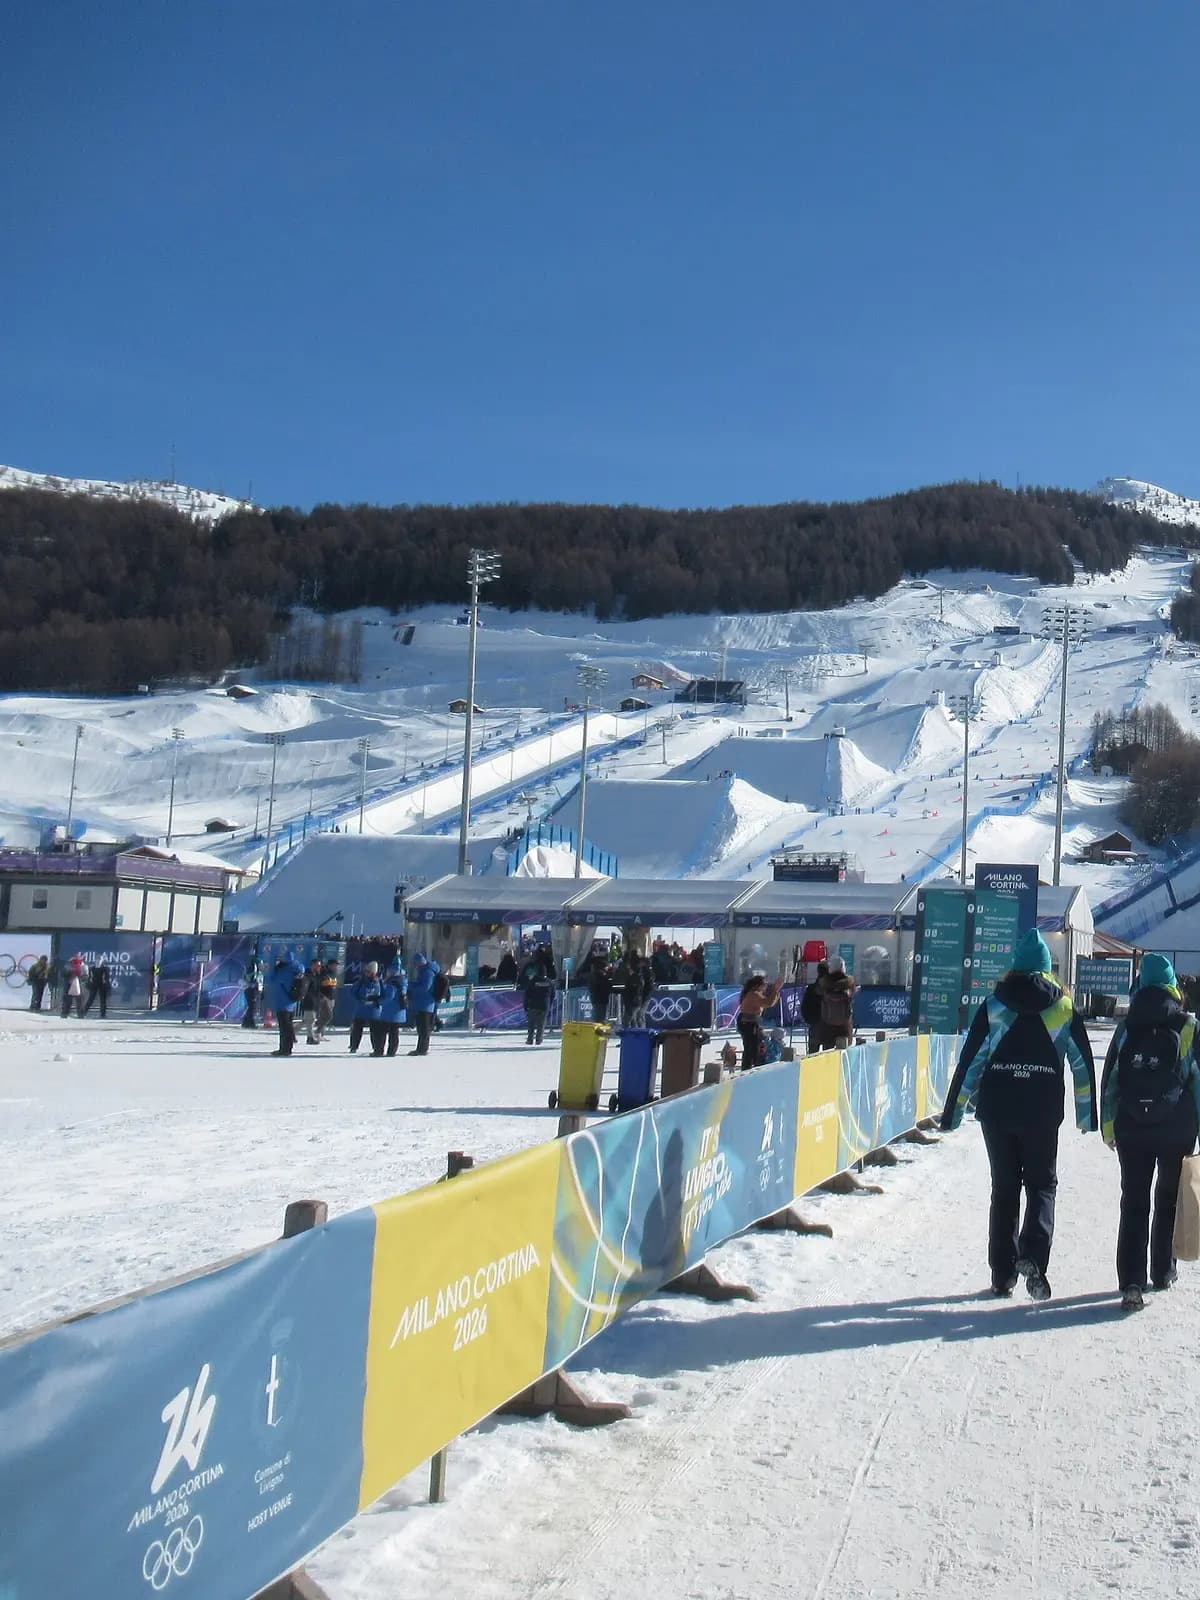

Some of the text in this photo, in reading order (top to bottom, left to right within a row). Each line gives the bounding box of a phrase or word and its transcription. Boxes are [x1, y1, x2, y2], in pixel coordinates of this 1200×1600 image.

[984, 873, 1022, 881] MILANO
[990, 881, 1030, 890] CORTINA
[868, 999, 905, 1007] MILANO
[882, 1015, 900, 1023] 2026
[991, 1063, 1056, 1074] MILANO CORTINA
[1014, 1070, 1031, 1078] 2026
[390, 1242, 540, 1349] MILANO CORTINA
[453, 1304, 487, 1351] 2026
[255, 1459, 283, 1484] Comune
[259, 1473, 285, 1495] Livigno
[127, 1463, 224, 1533] MILANO CORTINA
[164, 1501, 189, 1527] 2026
[248, 1492, 293, 1533] HOST VENUE
